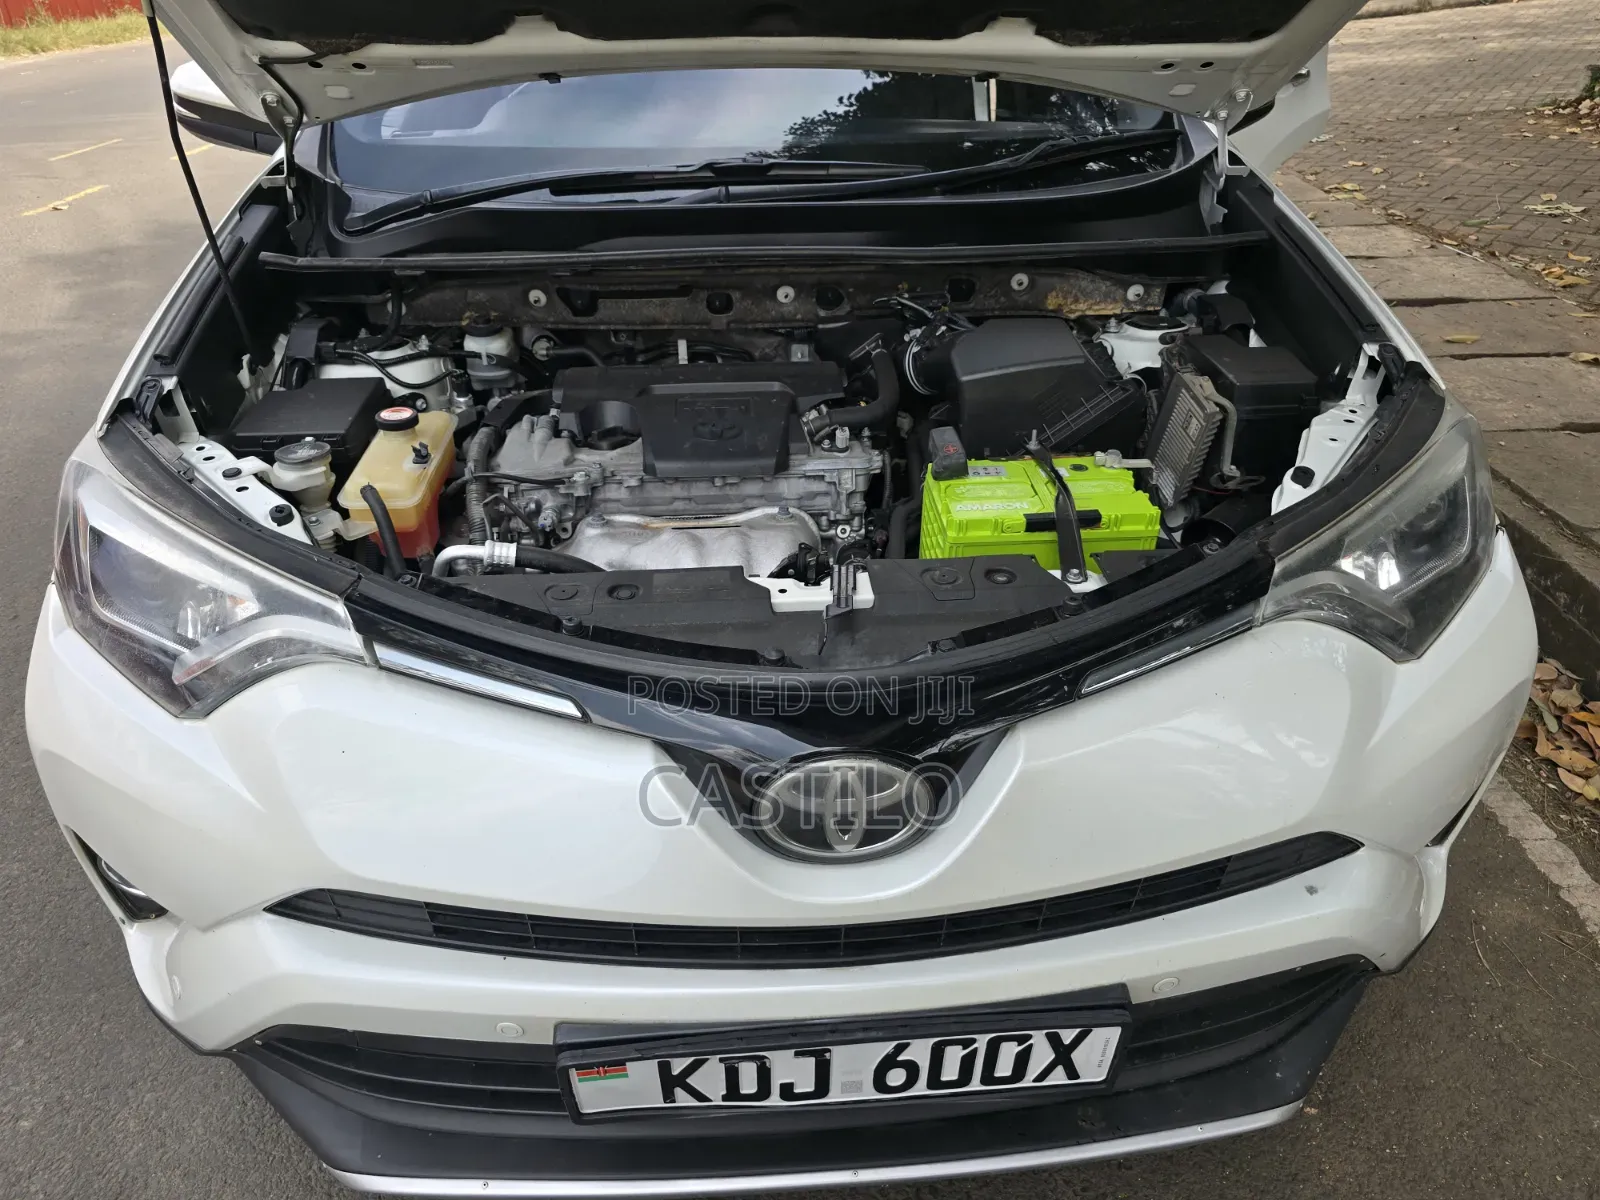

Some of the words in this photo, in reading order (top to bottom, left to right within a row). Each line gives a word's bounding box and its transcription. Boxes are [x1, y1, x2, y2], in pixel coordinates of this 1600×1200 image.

[956, 502, 1029, 511] AMARON
[657, 1048, 832, 1104] KDJ
[873, 1028, 1093, 1095] 600X
